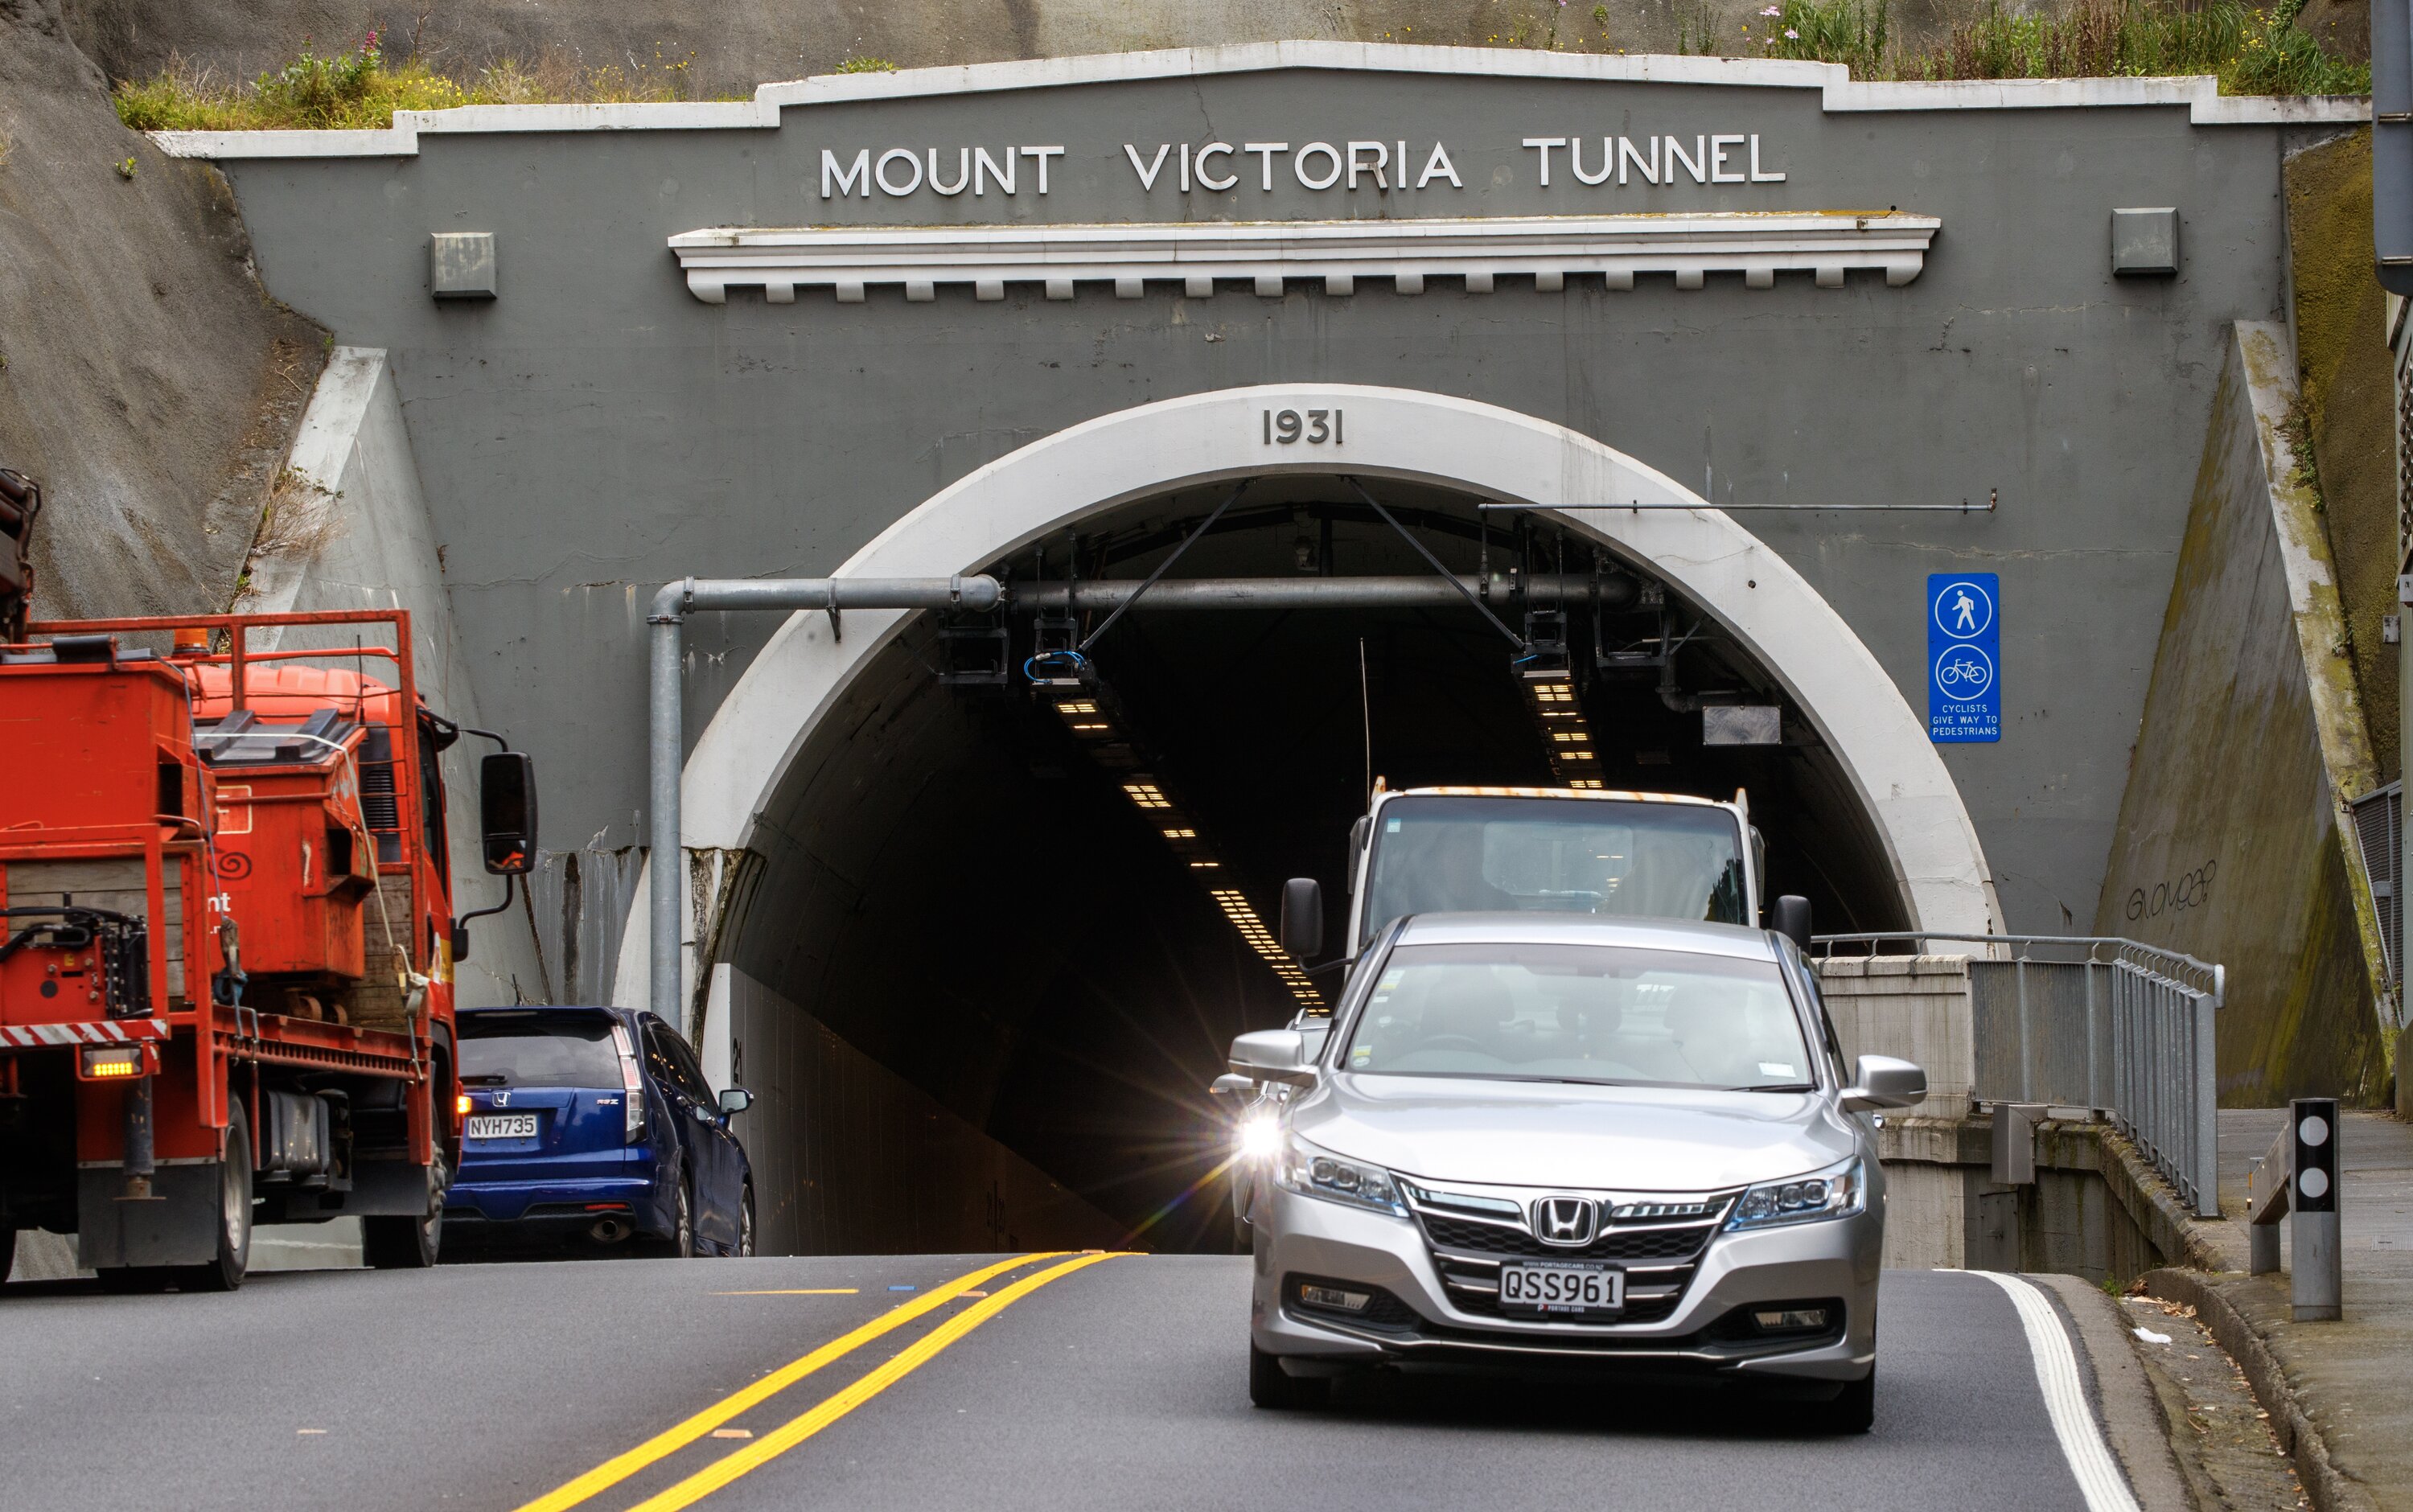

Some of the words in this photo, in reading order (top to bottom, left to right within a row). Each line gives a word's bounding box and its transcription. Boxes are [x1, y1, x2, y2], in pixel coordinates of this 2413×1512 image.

[821, 145, 1065, 198] MOUNT
[1124, 141, 1463, 192] VICTORIA
[1522, 134, 1786, 186] TUNNEL
[1263, 409, 1343, 445] 1931
[1942, 704, 1988, 713] CYCLISTS
[1932, 716, 1954, 725] GIVE
[1959, 715, 1979, 725] WAY
[1985, 715, 1998, 724] TO
[1933, 727, 1998, 736] PEDESTRIANS
[470, 1117, 534, 1136] NYH735
[1506, 1271, 1615, 1305] QSS961
